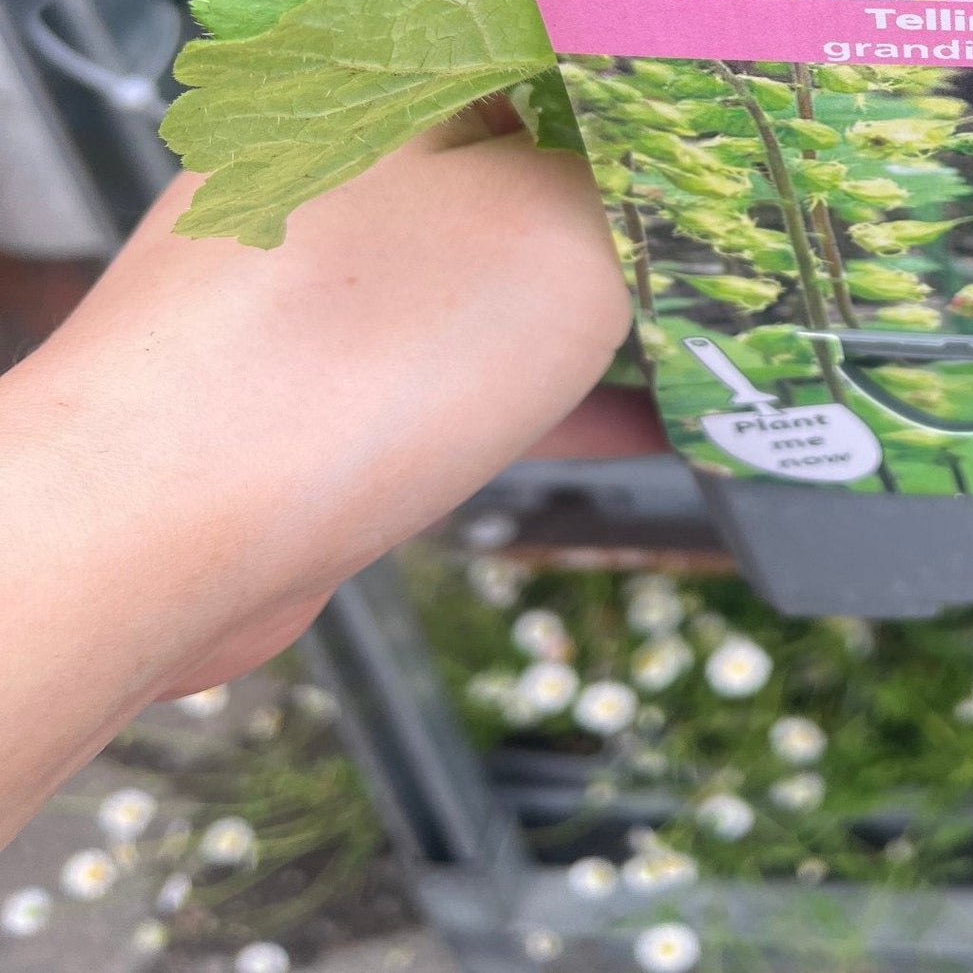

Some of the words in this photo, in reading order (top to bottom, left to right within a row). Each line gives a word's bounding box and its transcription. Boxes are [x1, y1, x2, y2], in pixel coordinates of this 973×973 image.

[735, 414, 828, 433] Plant
[773, 436, 824, 450] me
[781, 452, 850, 468] now
